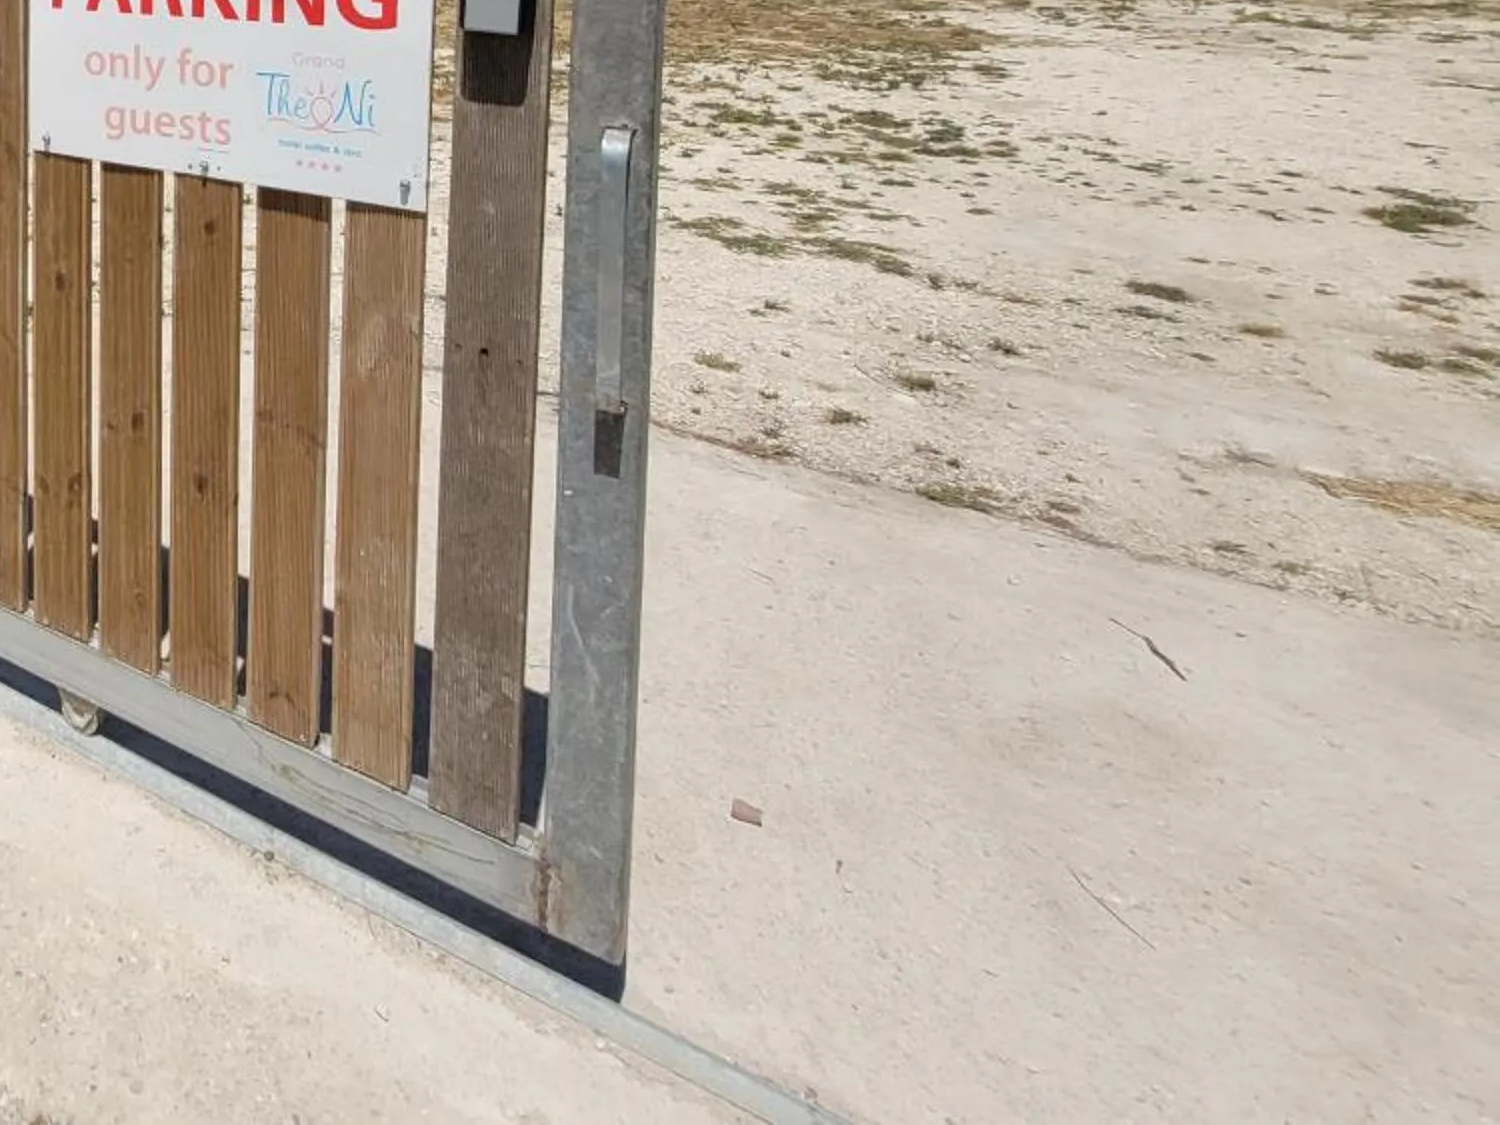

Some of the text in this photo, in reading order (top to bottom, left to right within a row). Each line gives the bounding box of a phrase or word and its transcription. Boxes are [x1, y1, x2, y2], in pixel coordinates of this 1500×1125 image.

[84, 43, 235, 91] only for
[104, 106, 232, 146] guests
